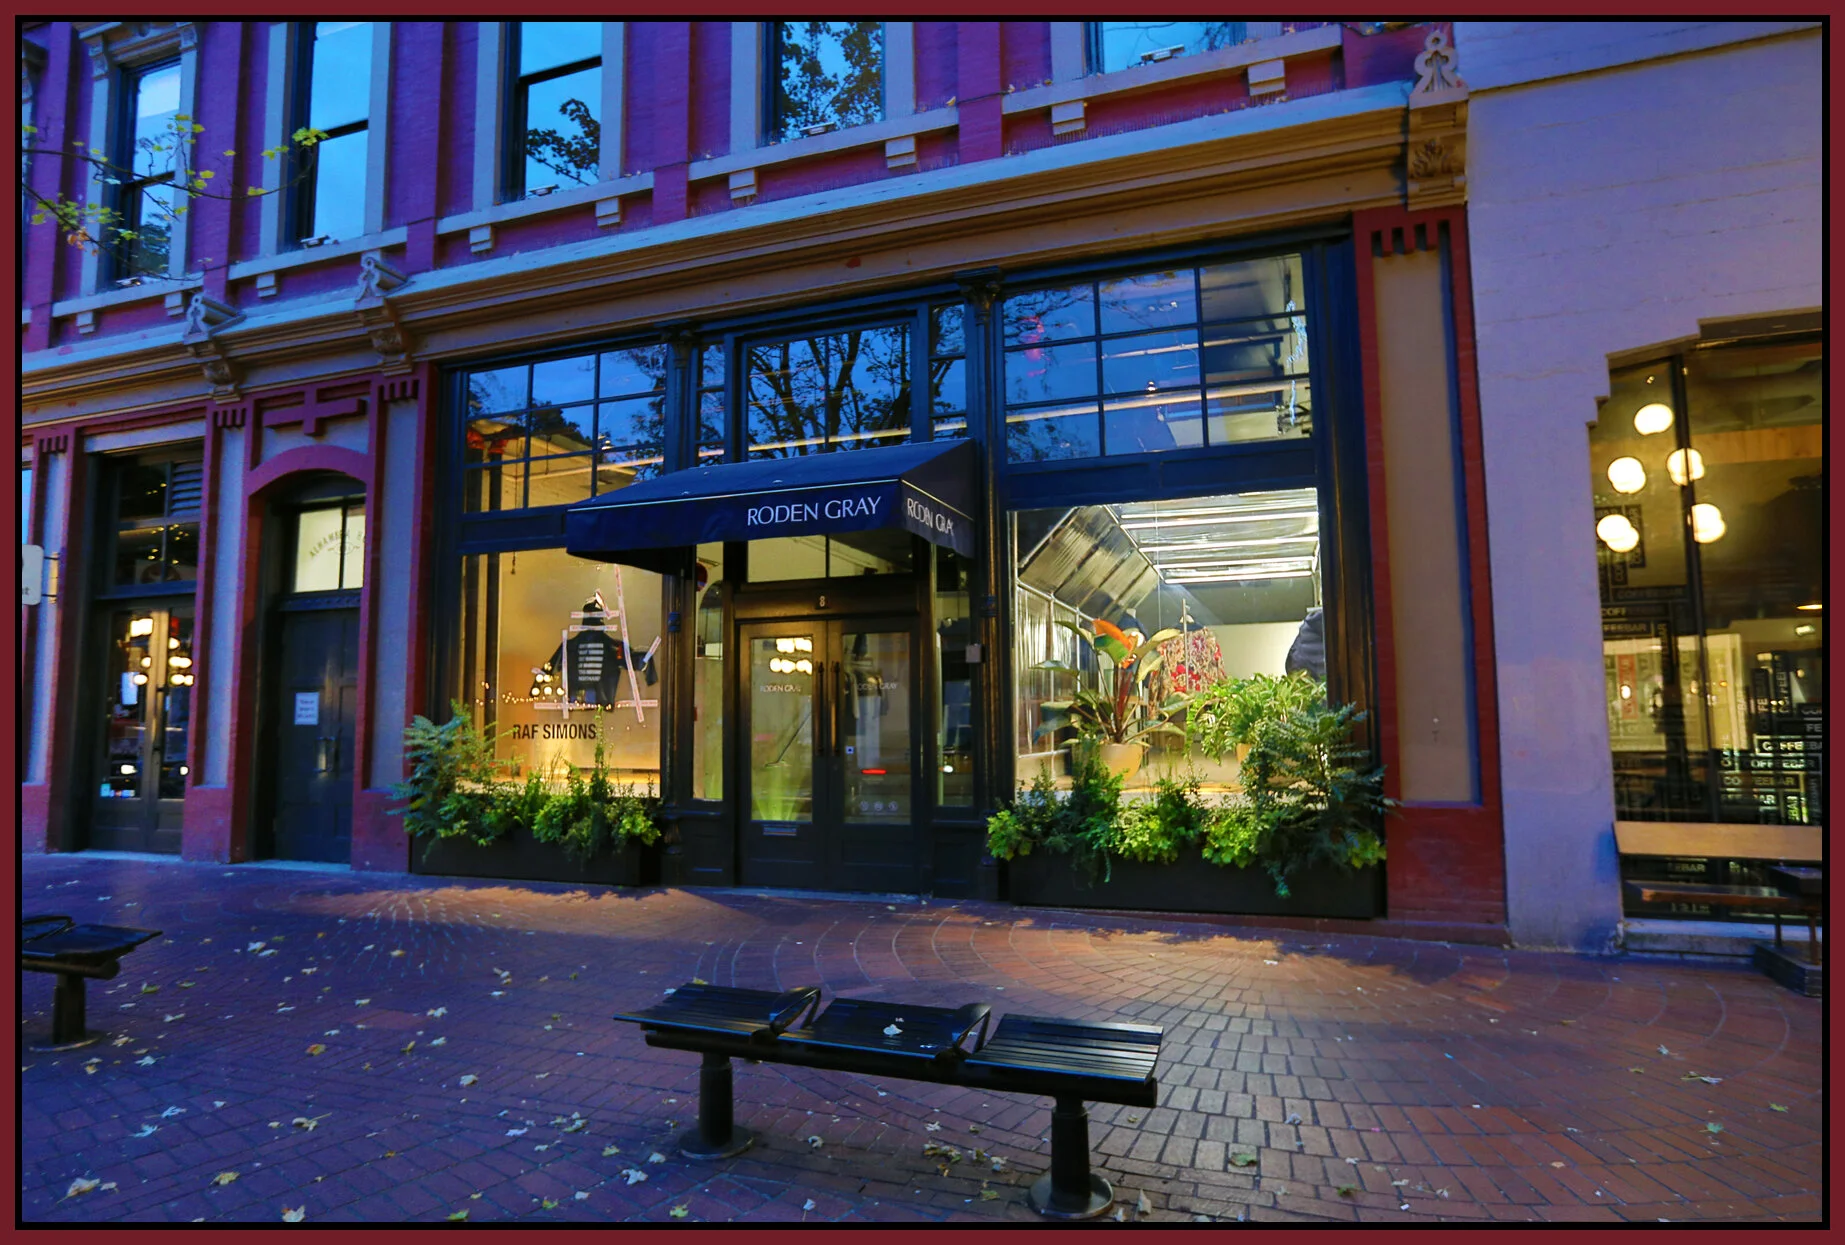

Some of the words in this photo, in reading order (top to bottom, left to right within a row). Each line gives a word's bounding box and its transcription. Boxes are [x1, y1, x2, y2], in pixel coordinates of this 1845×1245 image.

[747, 502, 820, 526] RODEN
[824, 496, 882, 519] GRAY
[819, 595, 826, 607] 8
[512, 724, 539, 739] RAF
[543, 723, 597, 740] SIMONS
